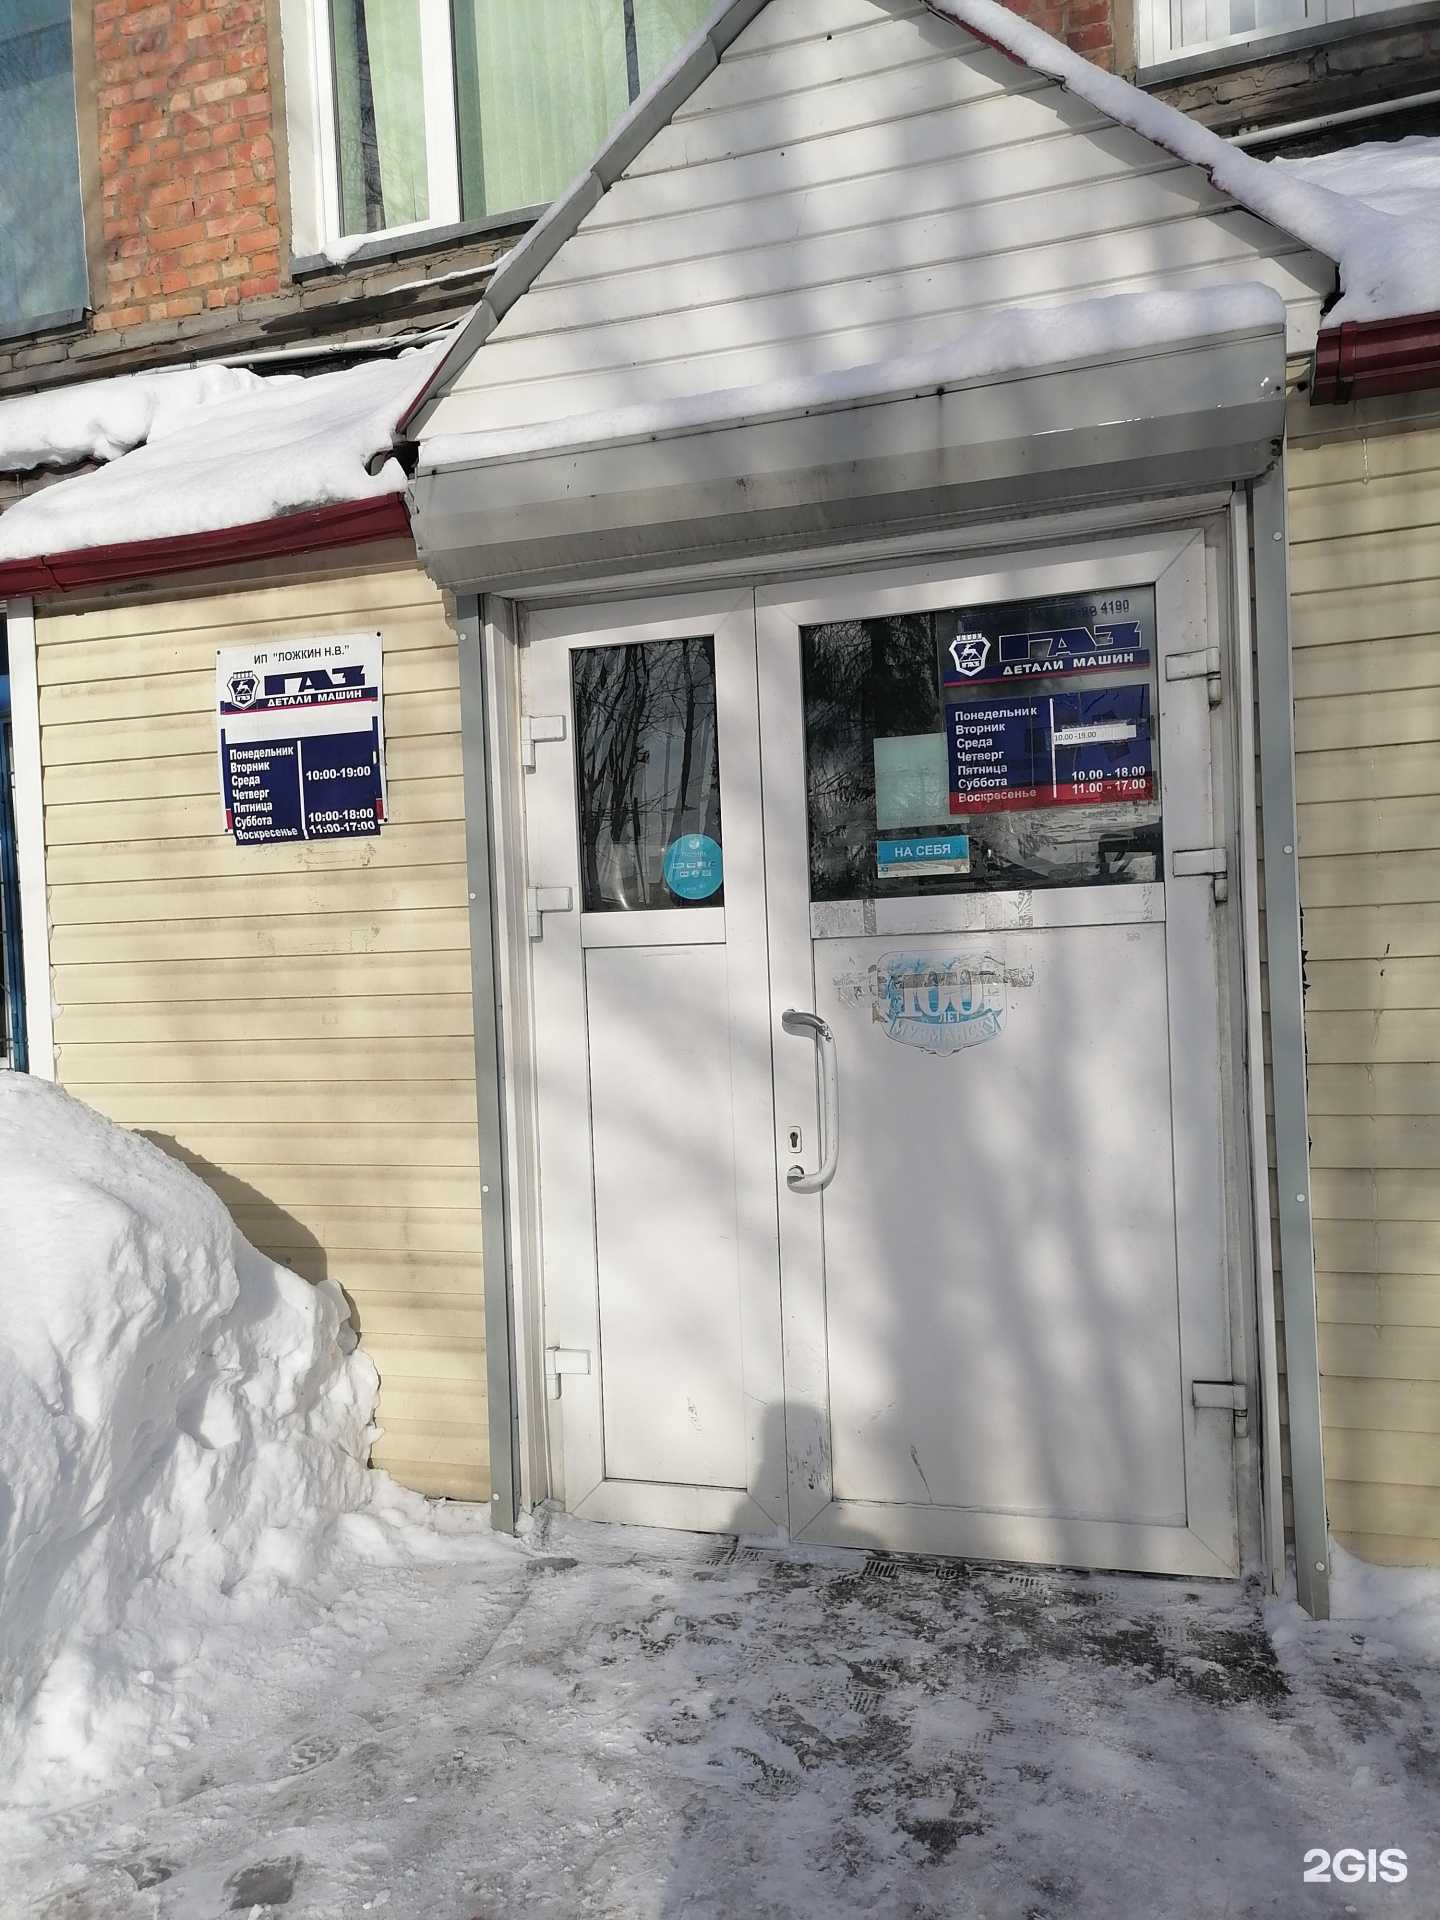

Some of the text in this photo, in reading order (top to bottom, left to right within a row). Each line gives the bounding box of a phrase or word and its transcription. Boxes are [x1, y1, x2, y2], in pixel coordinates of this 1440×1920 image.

[999, 620, 1142, 663] ГАЗ
[254, 645, 350, 665] ИП "ЛОЖКИН Н.В."
[1002, 652, 1134, 676] ДЕТАЛИ МАШИН
[264, 665, 365, 696] ГАЗ
[268, 690, 362, 707] ДЕТАЛИ МАШИН
[955, 706, 1037, 723] Понедельник
[955, 723, 1006, 737] Вторник
[956, 737, 993, 750] Среда
[229, 746, 294, 761] Понедельник
[957, 750, 1004, 764] Четверг
[230, 761, 270, 774] Вторник
[306, 766, 371, 781] 10:00-19:00
[957, 764, 1008, 776] Пятница
[1071, 769, 1103, 781] 10.00
[1114, 765, 1146, 778] 18.00
[231, 775, 260, 788] Среда
[958, 777, 1008, 790] Суббота
[1071, 782, 1103, 795] 11.00
[1116, 778, 1146, 792] 17.00
[232, 788, 270, 801] Четверг
[958, 789, 1037, 803] Воскресенье
[233, 801, 273, 813] Пятница
[234, 815, 273, 829] Суббота
[308, 808, 374, 822] 10:00-18:00
[236, 828, 298, 840] Воскресенье
[309, 820, 376, 834] 11:00-17:00
[894, 843, 951, 858] НА СЕБЯ
